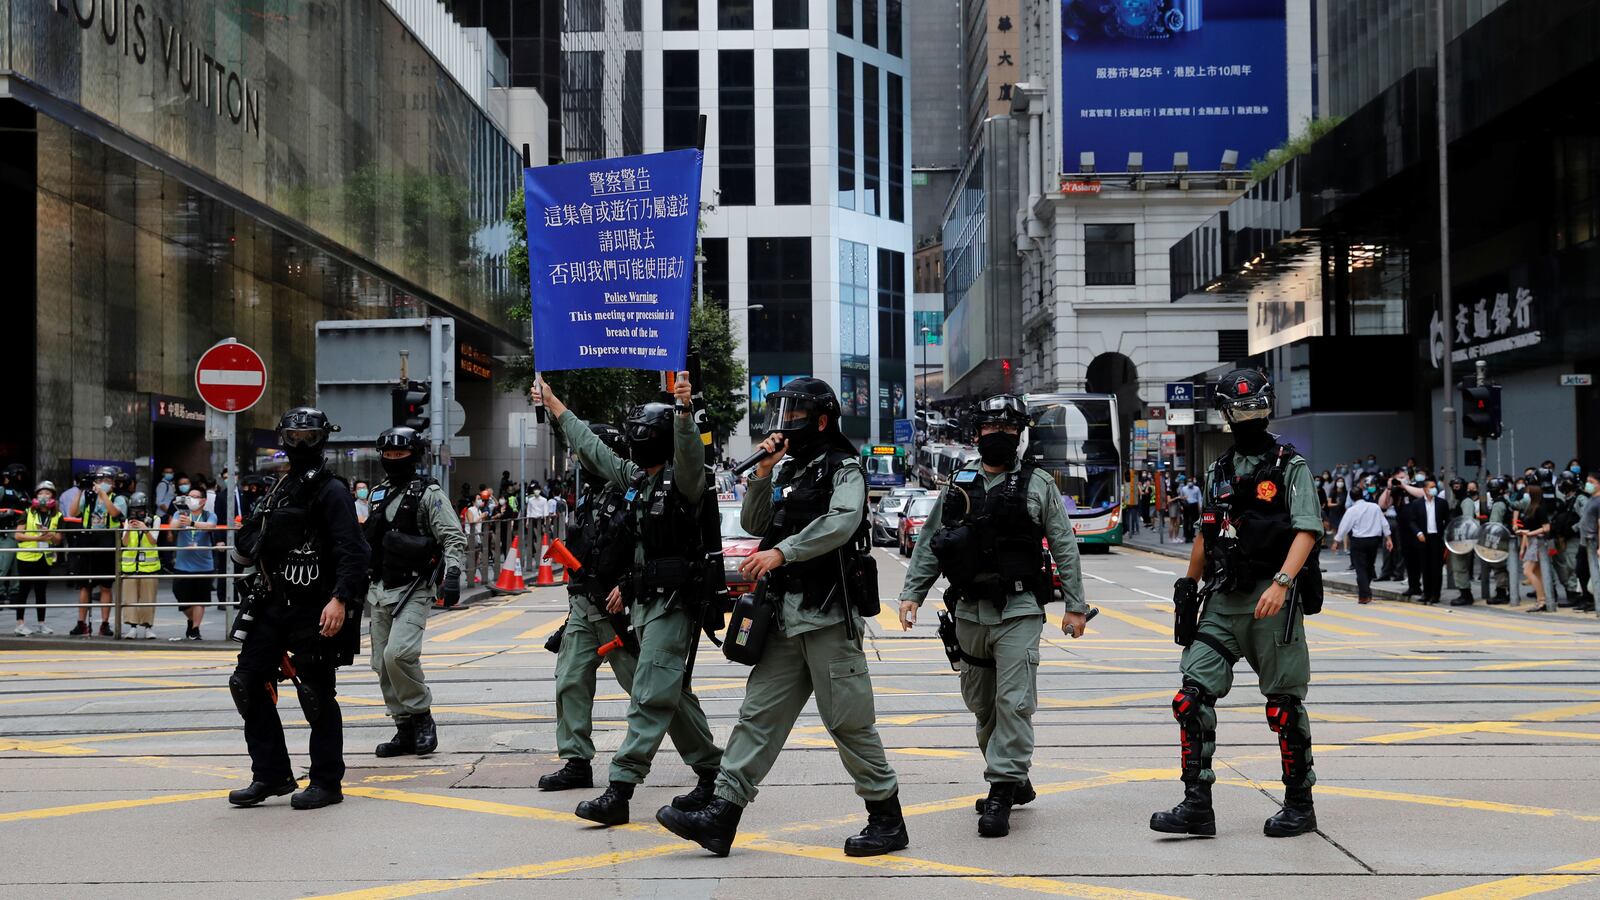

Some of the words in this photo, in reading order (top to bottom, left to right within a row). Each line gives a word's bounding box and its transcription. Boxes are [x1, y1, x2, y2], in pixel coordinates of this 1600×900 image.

[54, 0, 147, 65] OUIS
[158, 17, 260, 139] VUITTON
[589, 166, 652, 195] 警察警告
[1071, 182, 1102, 192] Asiaray
[544, 193, 690, 228] 這集會或遊行乃屬違法
[598, 226, 656, 253] 請即散去
[548, 256, 684, 285] 否則我們可能使用武力
[604, 292, 628, 303] Police
[569, 311, 592, 322] This
[595, 309, 625, 322] meeting
[626, 312, 635, 320] or
[636, 309, 665, 322] procession
[606, 327, 630, 337] breach
[631, 327, 638, 337] of
[639, 327, 648, 337] the
[649, 327, 658, 338] law.
[579, 345, 620, 357] Disperse
[620, 347, 628, 355] or
[629, 347, 637, 355] we
[638, 347, 648, 358] may
